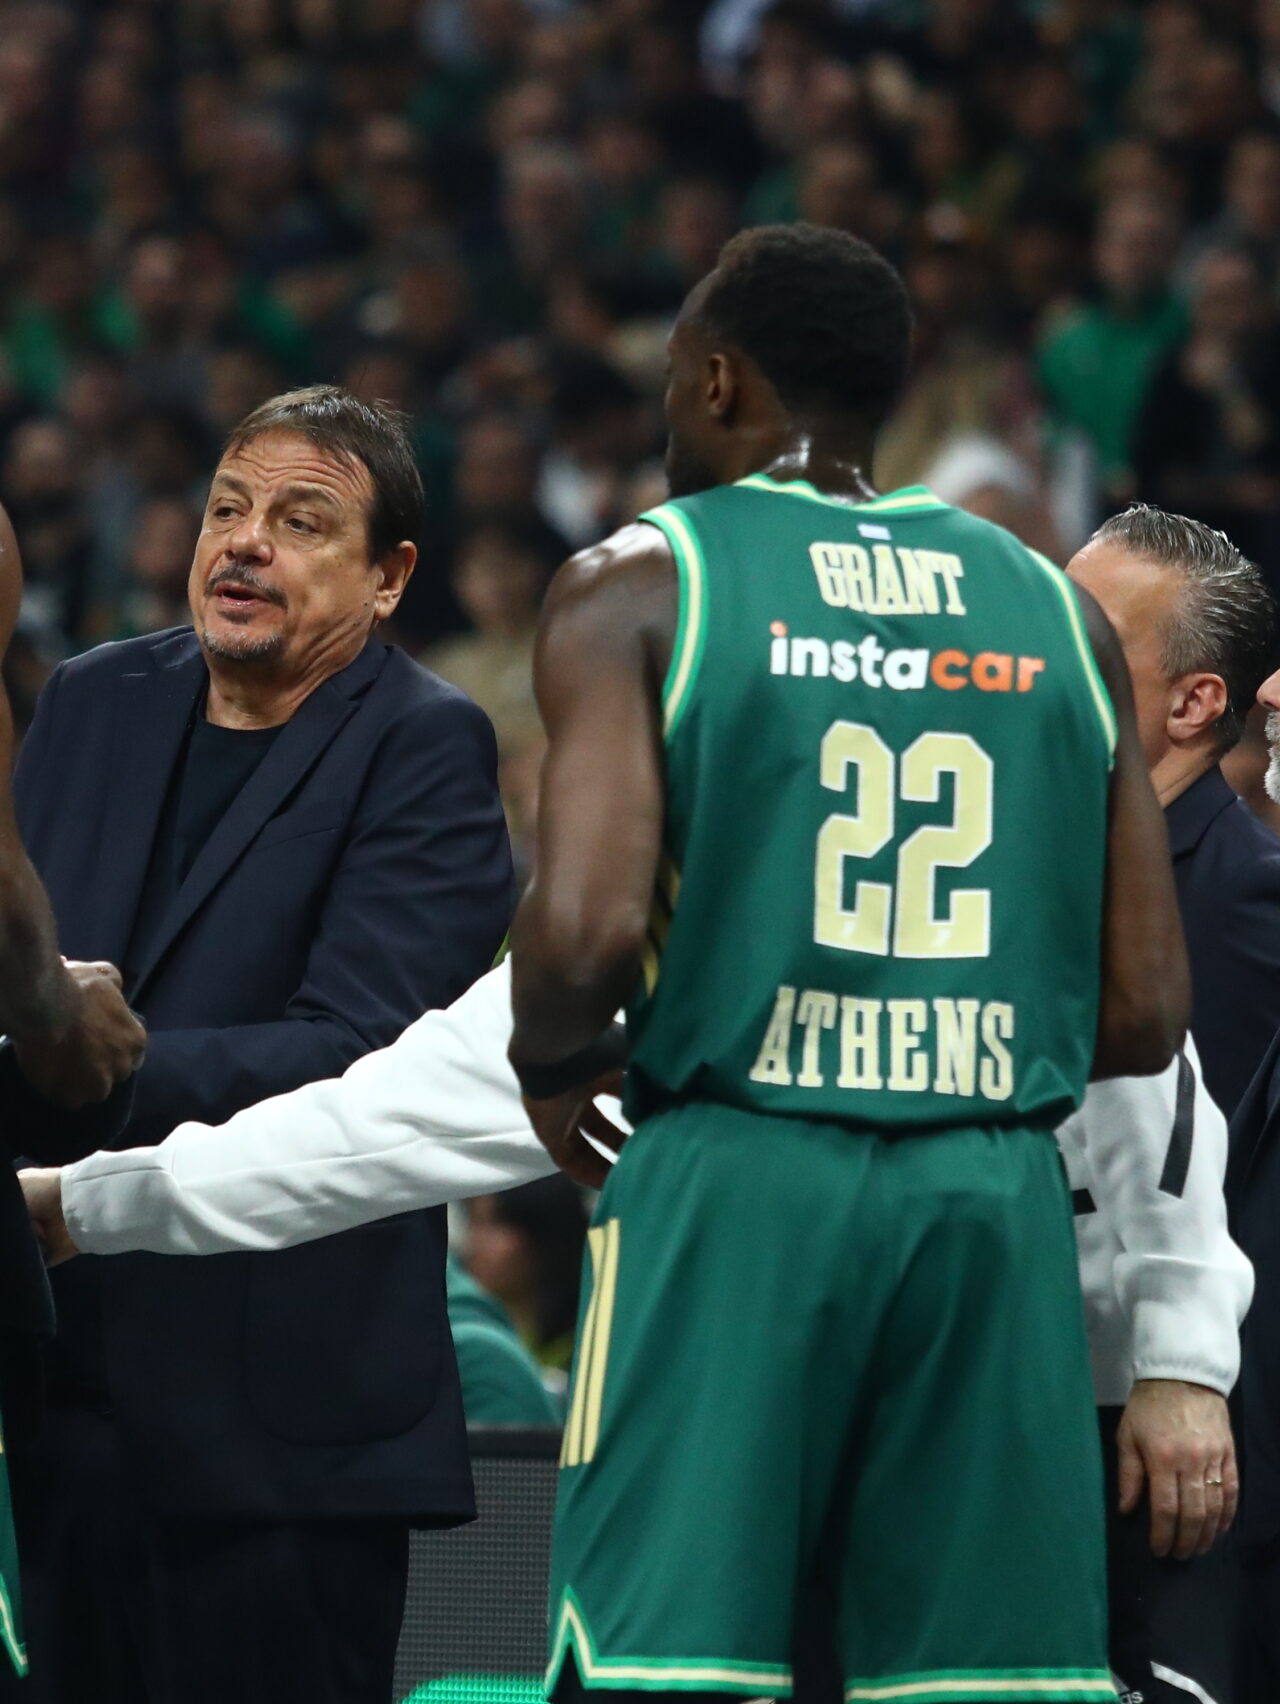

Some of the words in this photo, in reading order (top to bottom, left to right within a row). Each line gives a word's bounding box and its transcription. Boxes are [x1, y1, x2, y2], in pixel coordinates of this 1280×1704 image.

[808, 541, 967, 616] GRANT
[770, 620, 1046, 692] instacar
[814, 720, 994, 959] 22
[749, 985, 1015, 1101] ATHENS
